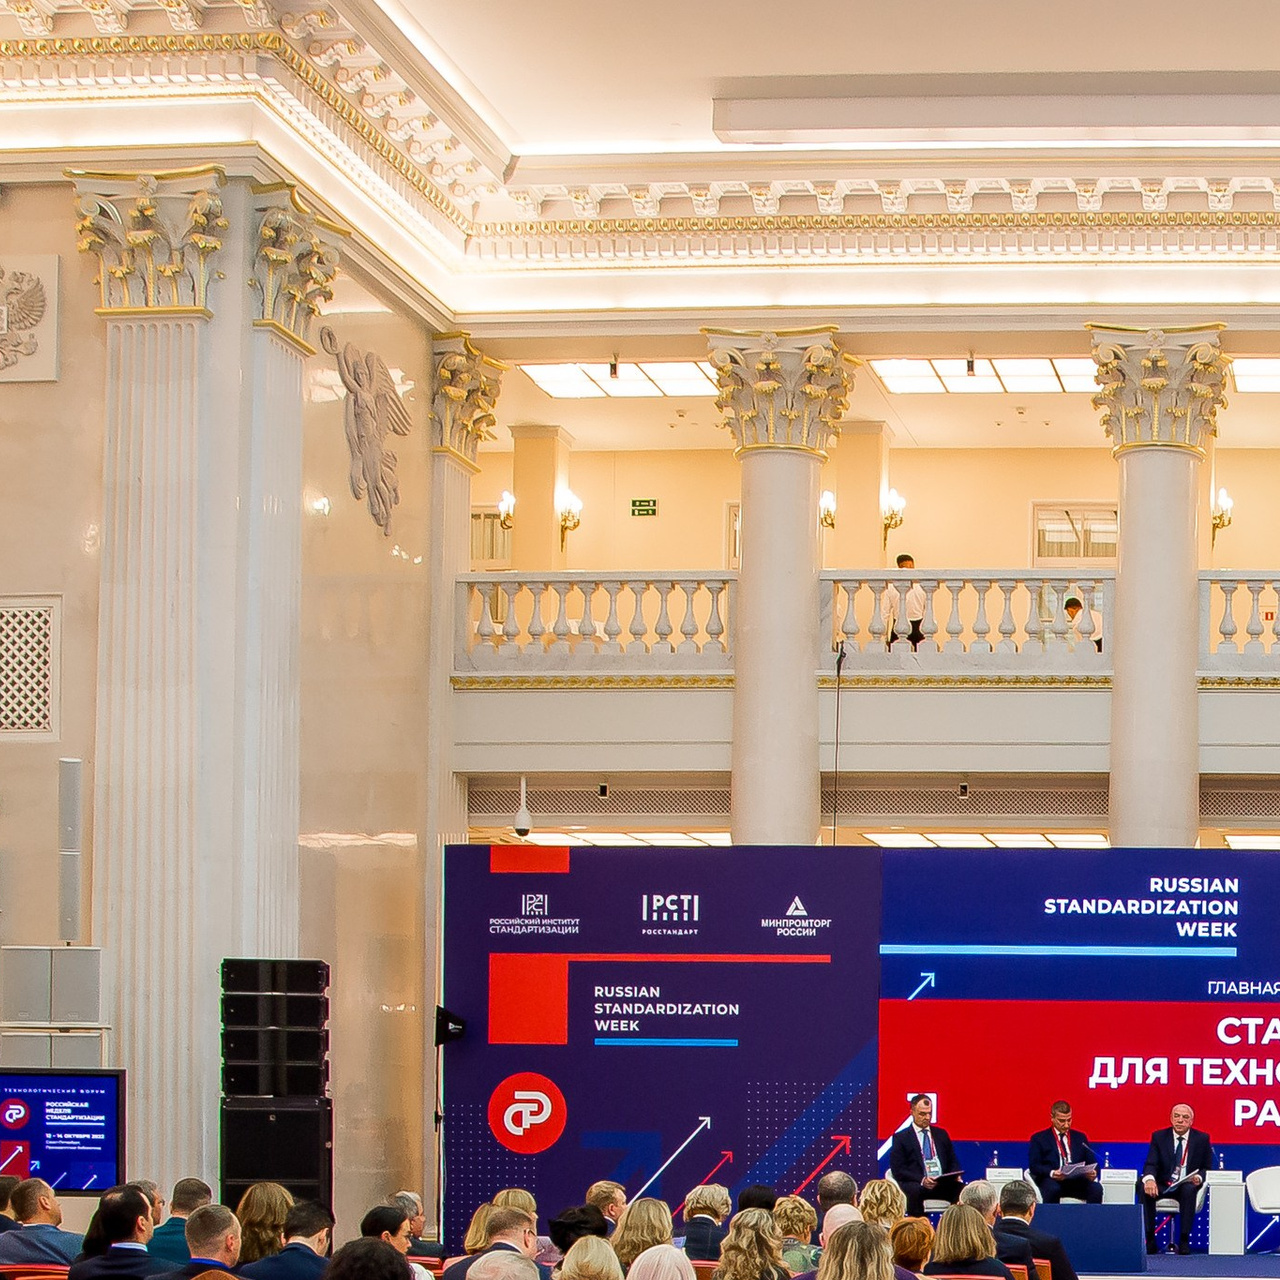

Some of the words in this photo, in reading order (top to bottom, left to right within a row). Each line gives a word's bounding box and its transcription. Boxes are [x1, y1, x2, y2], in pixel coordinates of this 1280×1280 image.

[1149, 877, 1239, 894] RUSSIAN
[1044, 898, 1239, 916] STANDARDIZATION
[489, 917, 541, 926] РОССИЙСКИЙ
[541, 918, 580, 926] ИНСТИТУТ
[761, 918, 832, 928] МИНПРОМТОРГ
[489, 925, 579, 935] СТАНДАРТИЗАЦИИ
[641, 928, 699, 936] РОССТАНДАРТ
[776, 927, 817, 937] РОССИИ
[1175, 921, 1238, 938] WEEK
[594, 986, 660, 998] RUSSIAN
[594, 1002, 740, 1016] STANDARDIZATION
[594, 1019, 640, 1032] WEEK
[1088, 1056, 1169, 1089] ДЛЯ
